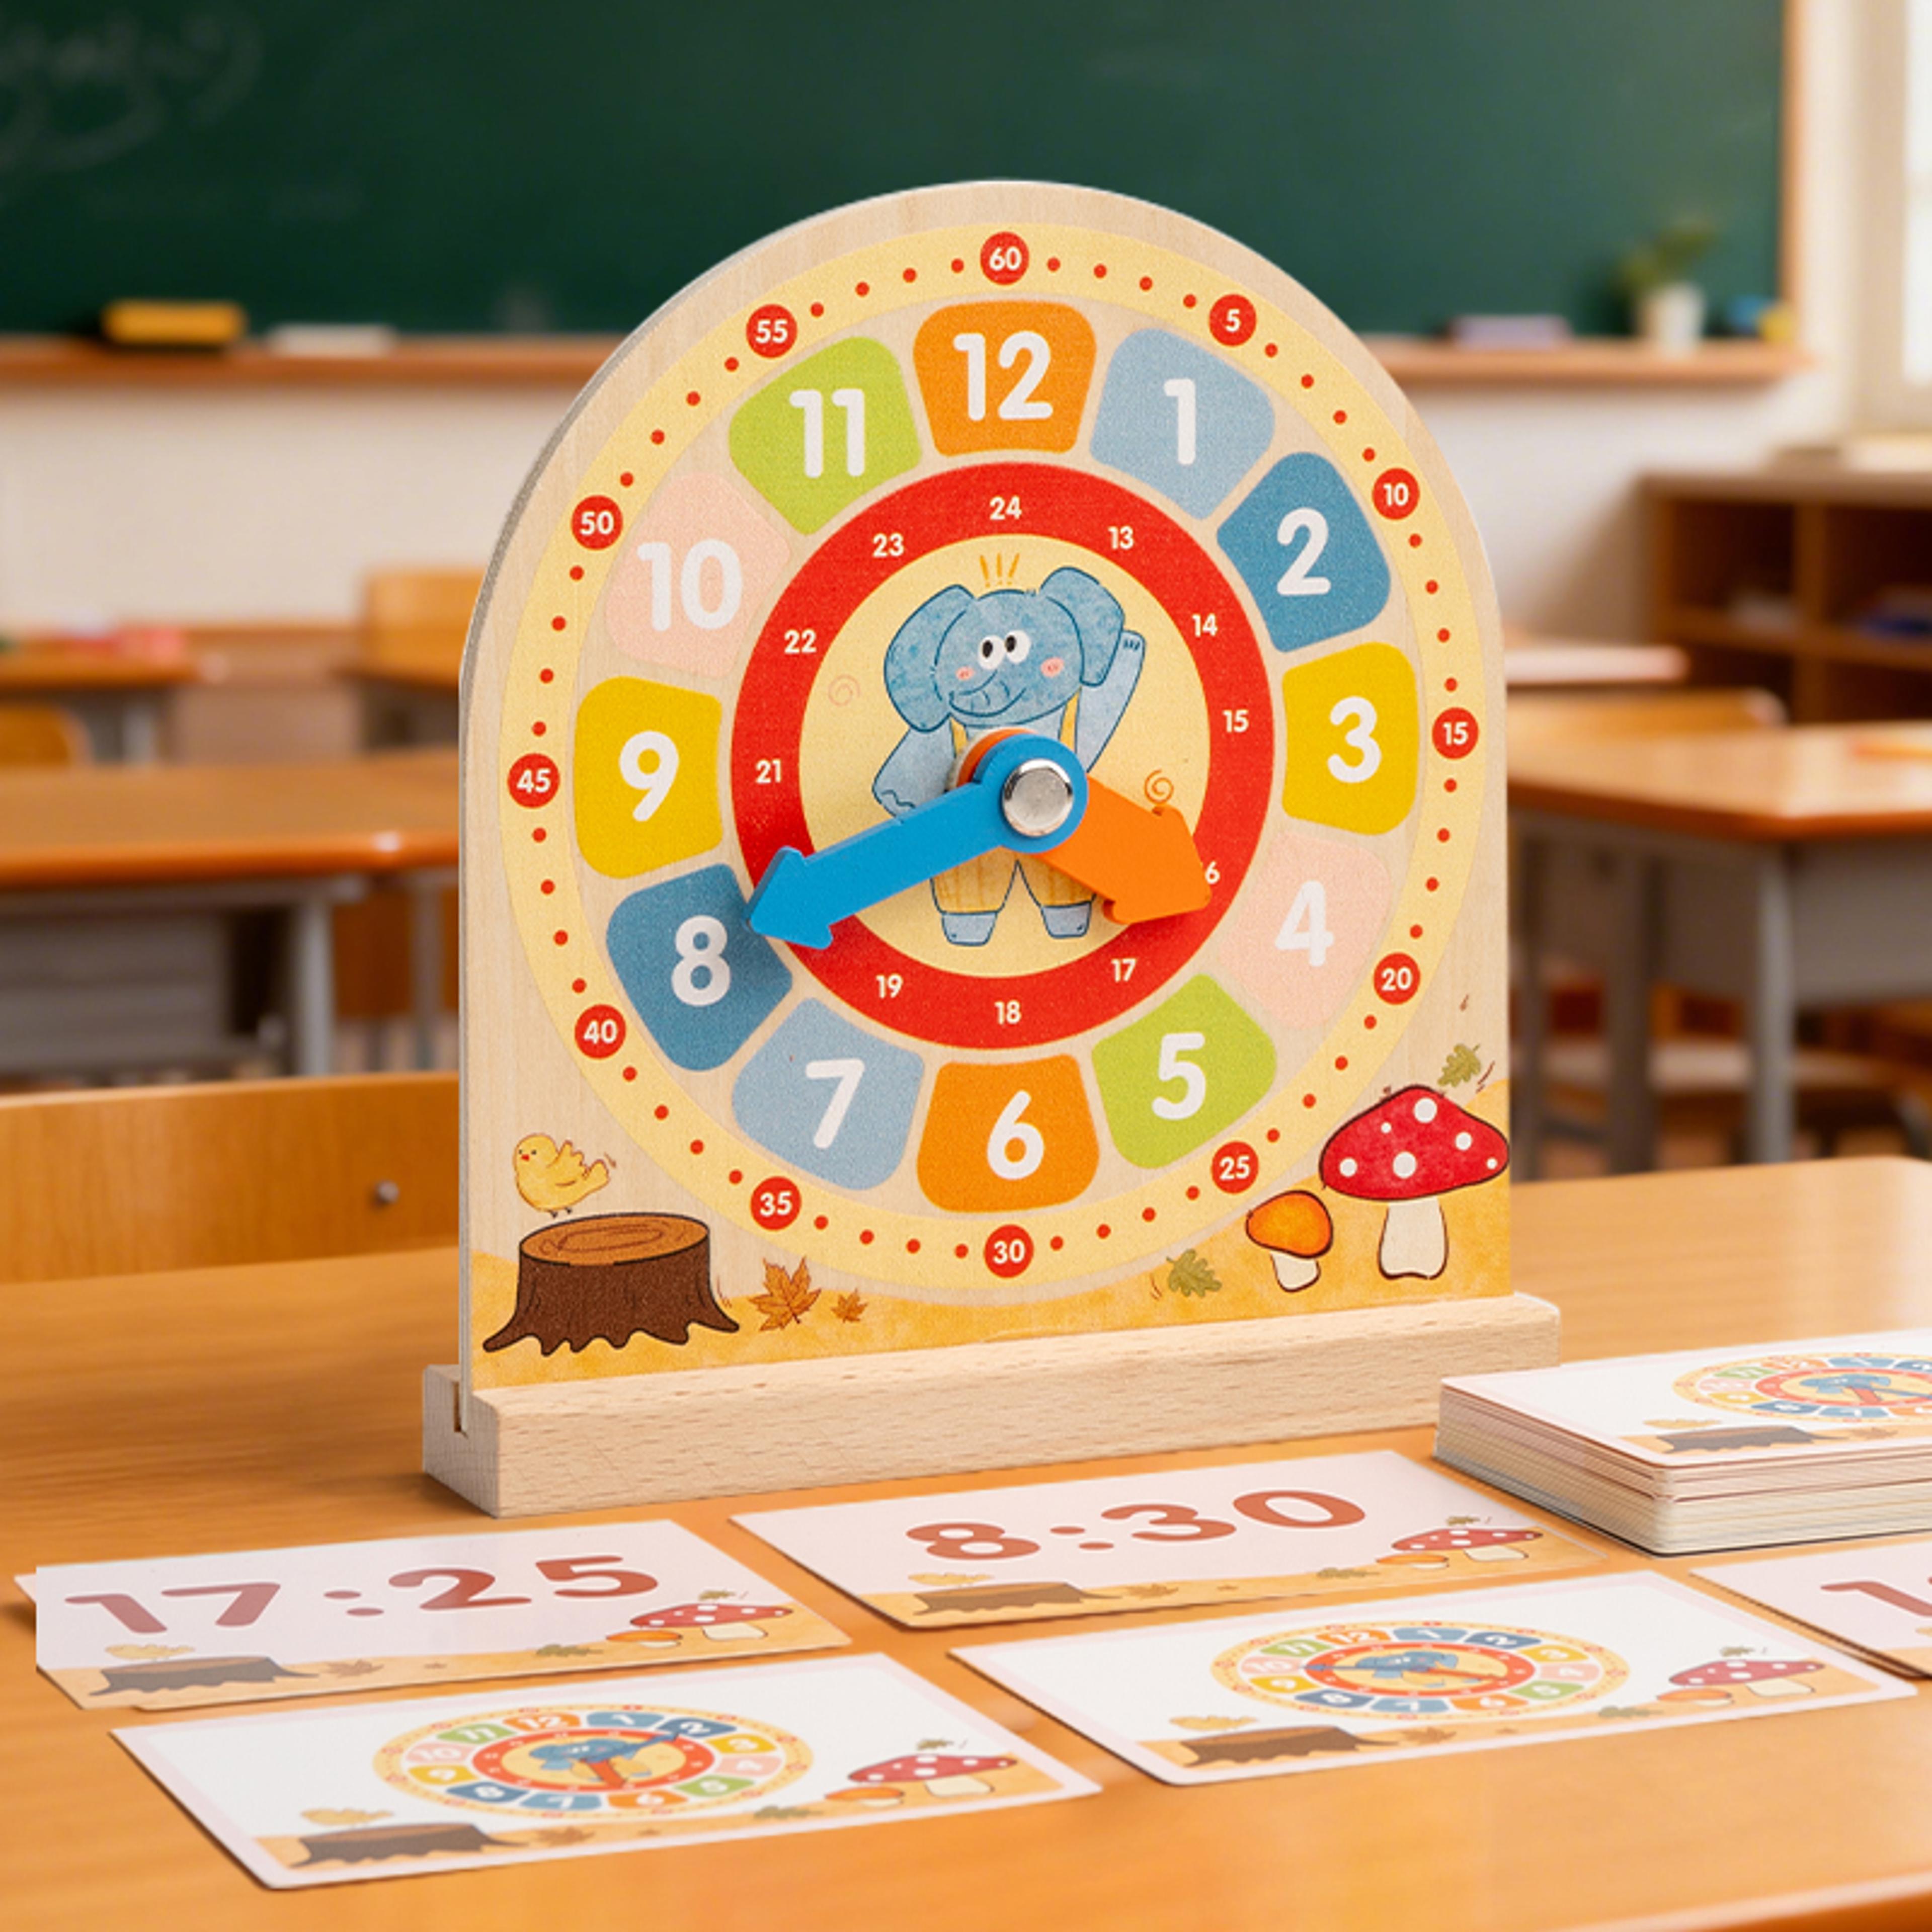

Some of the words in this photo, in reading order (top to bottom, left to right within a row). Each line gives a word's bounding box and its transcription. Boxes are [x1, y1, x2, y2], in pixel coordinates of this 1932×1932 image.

[990, 247, 1021, 271] 60
[756, 319, 787, 343] 55
[1226, 309, 1240, 333] 5
[954, 331, 1053, 421] 12
[789, 389, 865, 478] 11
[1164, 378, 1196, 465] 1
[1384, 483, 1409, 506] 10
[990, 497, 1021, 520] 24
[581, 511, 613, 535] 50
[873, 533, 904, 557] 23
[1108, 526, 1134, 549] 13
[1277, 507, 1331, 596] 2
[637, 538, 743, 631] 10
[1192, 614, 1218, 636] 14
[785, 630, 816, 654] 22
[1224, 710, 1248, 733] 15
[1443, 722, 1468, 745] 15
[1328, 696, 1382, 783] 3
[517, 769, 550, 793] 45
[619, 731, 679, 821] 9
[756, 760, 780, 784] 21
[1205, 862, 1220, 884] 6
[1275, 880, 1334, 967] 4
[671, 915, 731, 1006] 8
[1111, 958, 1136, 982] 17
[876, 975, 903, 998] 19
[1382, 967, 1412, 991] 20
[995, 1001, 1021, 1024] 18
[584, 1020, 617, 1044] 40
[1152, 1032, 1205, 1119] 5
[805, 1058, 865, 1149] 7
[987, 1091, 1044, 1180] 6
[1220, 1156, 1250, 1180] 25
[760, 1191, 791, 1217] 35
[994, 1240, 1025, 1264] 30
[906, 1490, 1365, 1560] 8:30
[64, 1555, 660, 1634] 17:25
